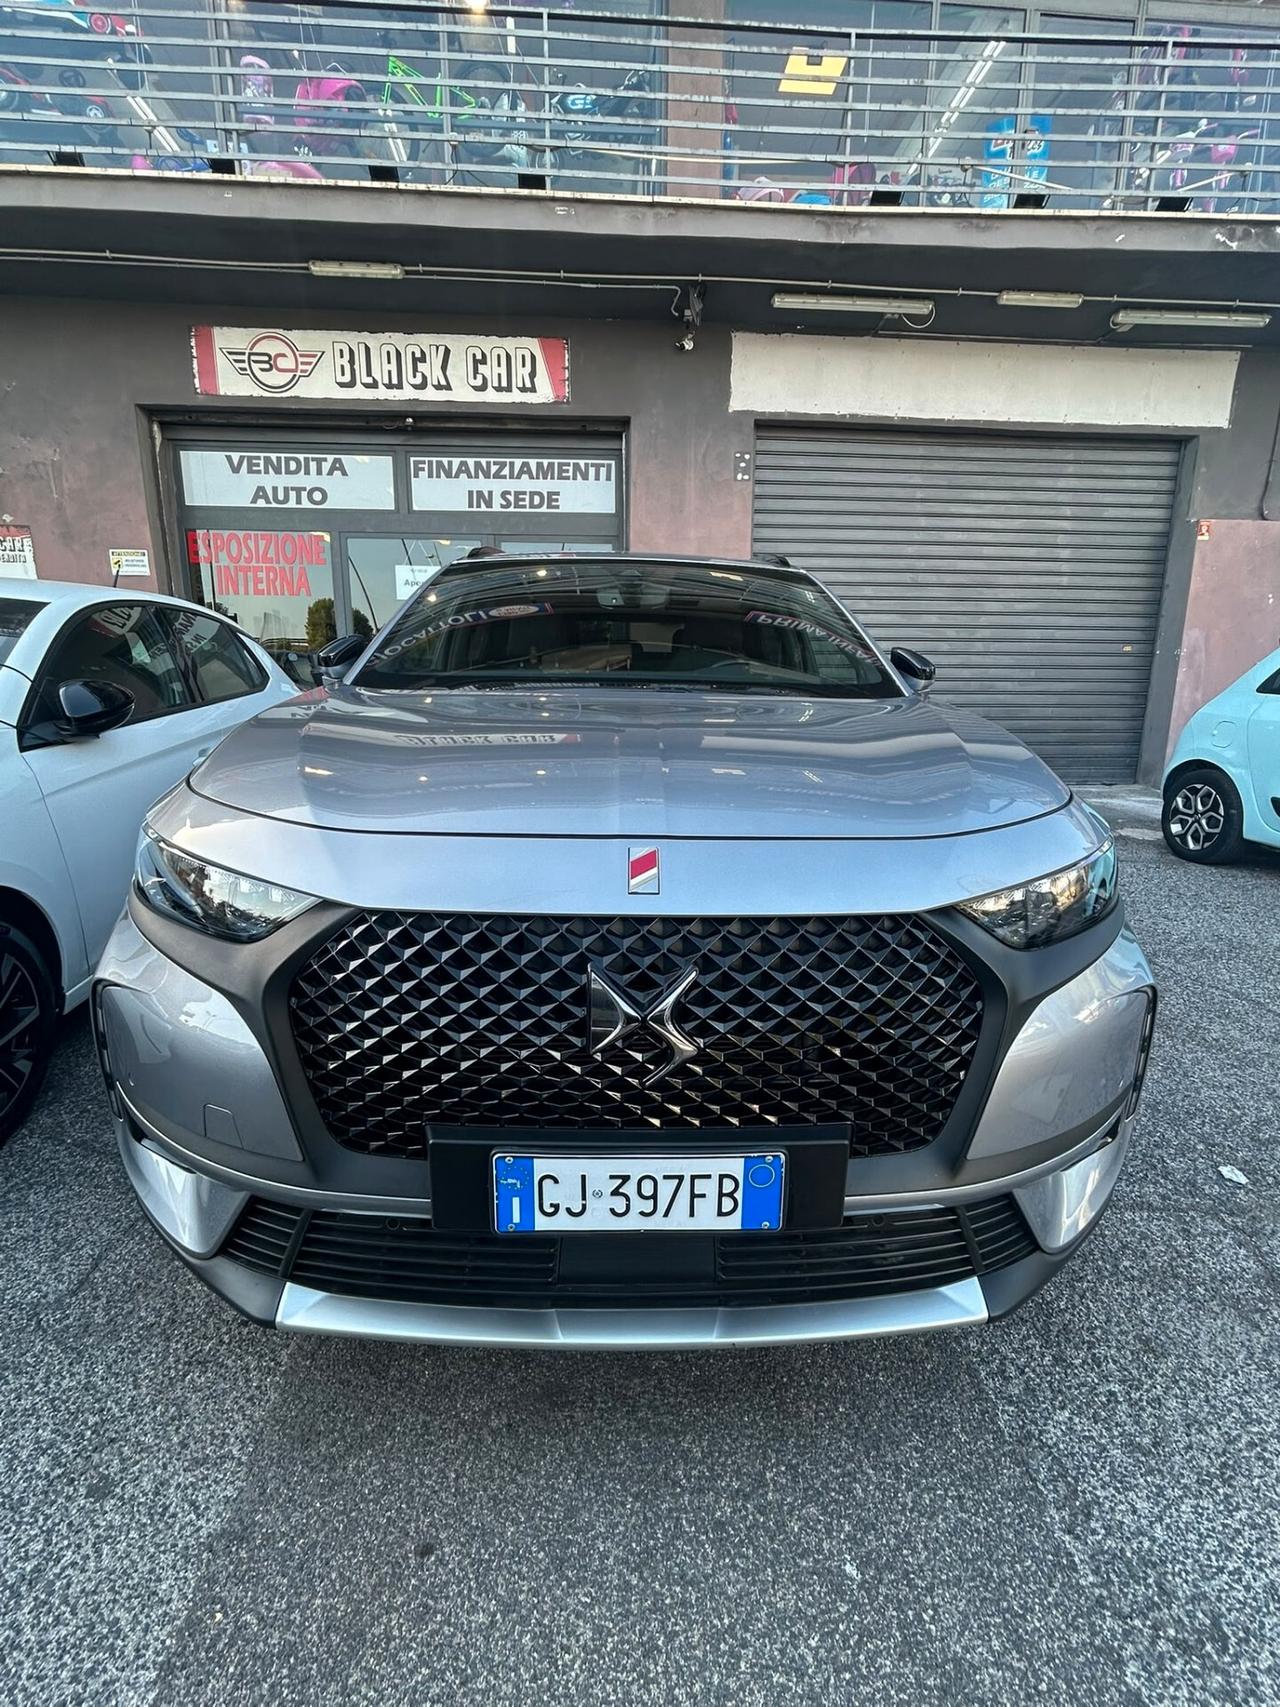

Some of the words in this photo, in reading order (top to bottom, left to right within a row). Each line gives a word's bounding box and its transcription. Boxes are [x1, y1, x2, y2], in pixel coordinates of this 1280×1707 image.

[332, 341, 452, 391] BLACK
[465, 345, 538, 393] CAR
[225, 455, 349, 477] VENDITA
[413, 459, 613, 482] FINANZIAMENTI
[250, 485, 328, 507] AUTO
[467, 489, 495, 510] IN
[499, 489, 561, 510] SEDE
[187, 531, 327, 566] ESPOSIZIONE
[216, 565, 312, 597] INTERNA
[404, 579, 422, 588] Ape
[537, 1173, 588, 1218] GJ
[608, 1173, 740, 1218] 397FB
